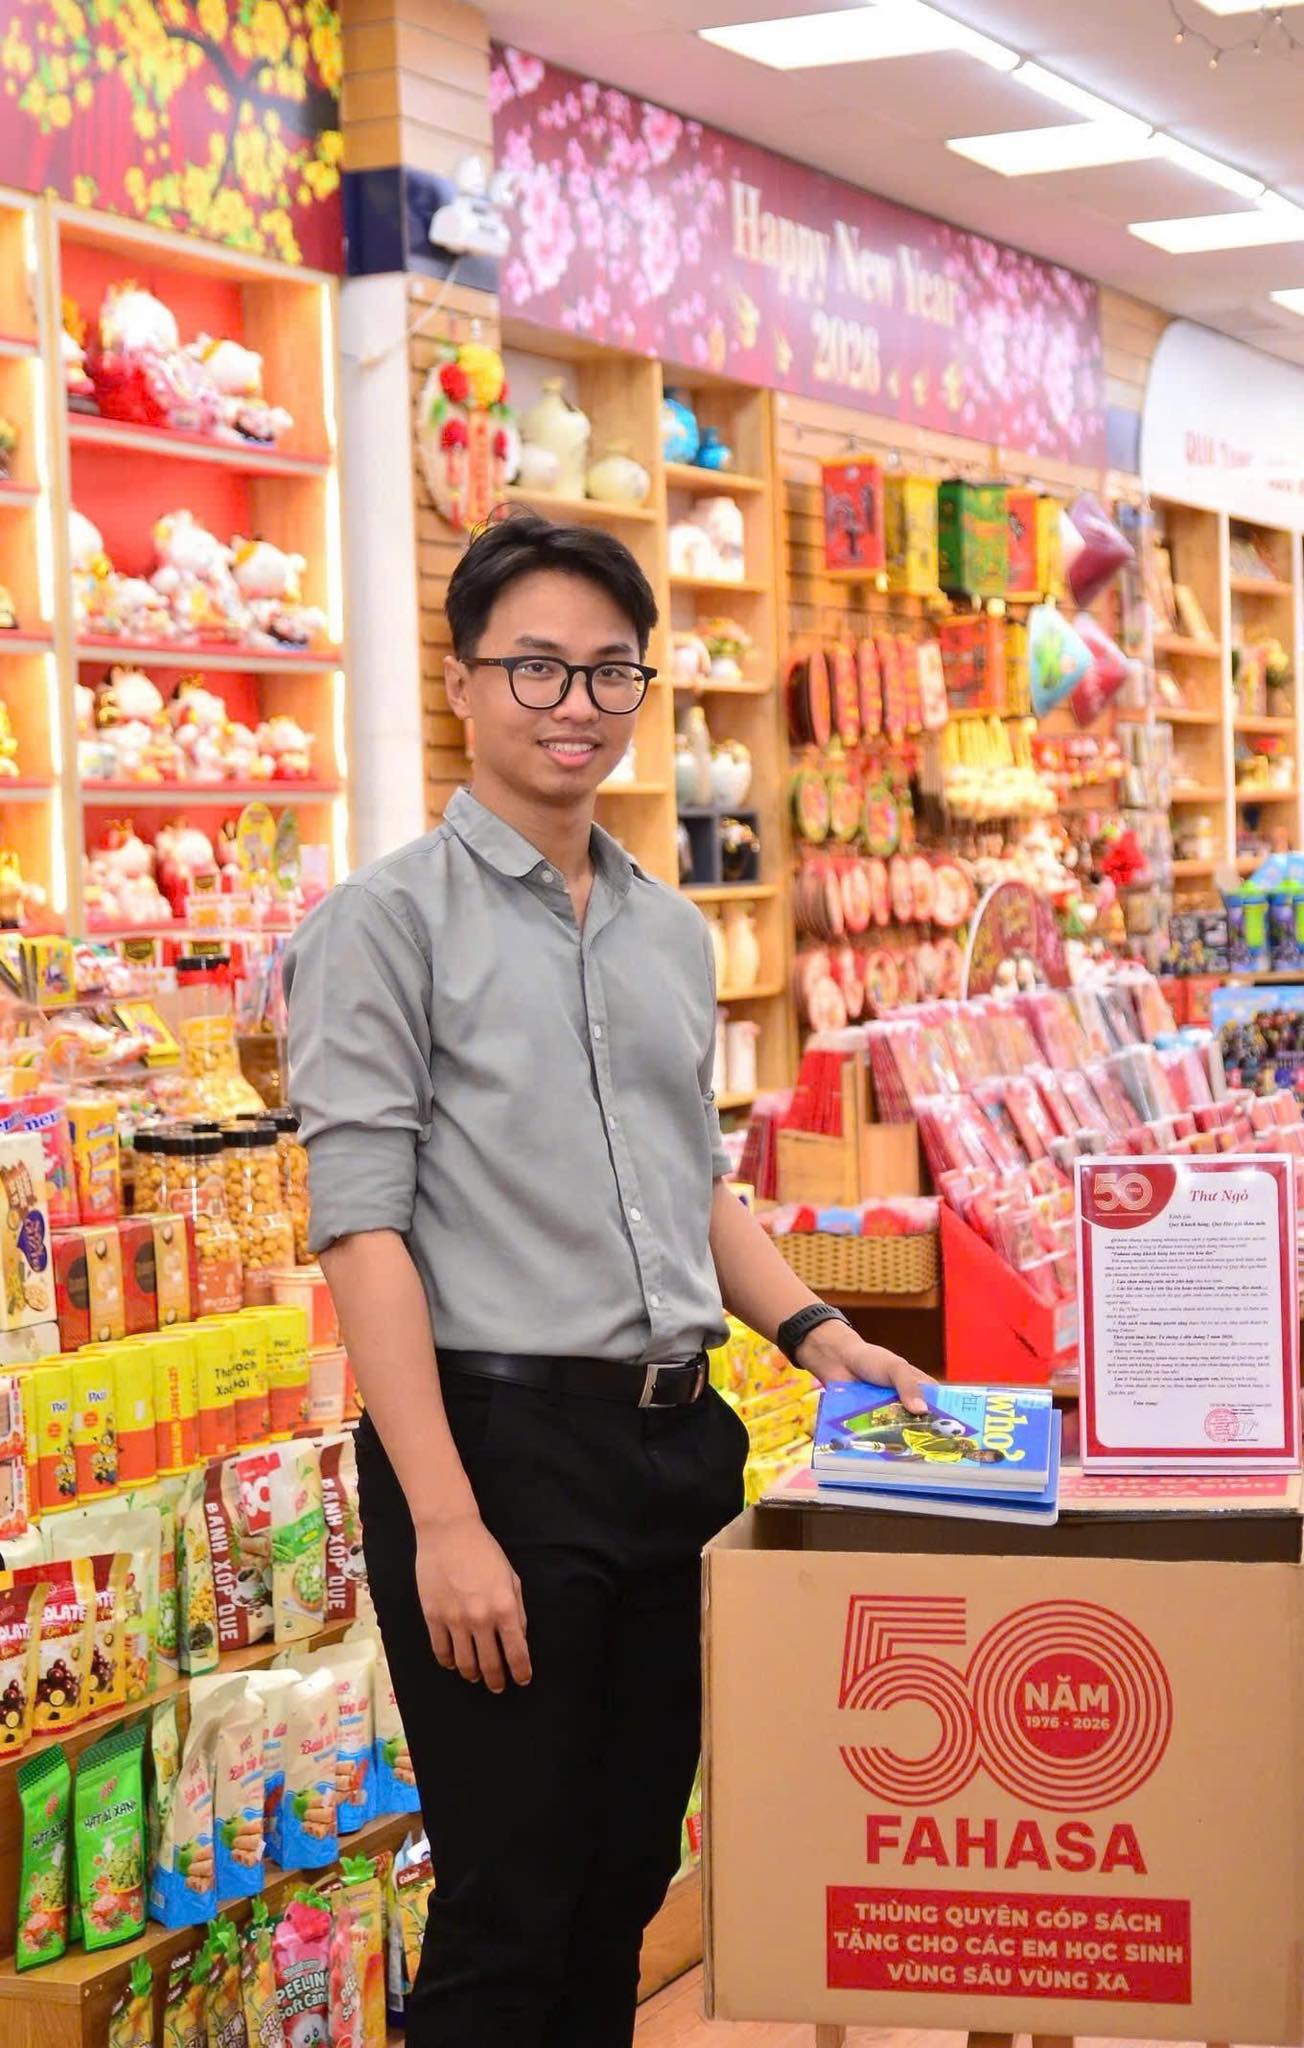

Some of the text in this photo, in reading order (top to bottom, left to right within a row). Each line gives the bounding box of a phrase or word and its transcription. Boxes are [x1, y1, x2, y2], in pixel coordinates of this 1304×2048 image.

[731, 179, 960, 328] Happy New Year
[811, 308, 880, 396] 2026
[1094, 1172, 1153, 1211] 50
[838, 1594, 1173, 1814] 50
[1024, 1673, 1110, 1714] NĂM
[1025, 1715, 1060, 1729] 1976
[1073, 1717, 1111, 1731] 2026
[866, 1814, 1148, 1875] FAHASA
[855, 1899, 1162, 1933] THÙNG QUYÊN GÓP SÁCH
[834, 1927, 1184, 1964] TẶNG CHO CÁC EM HỌC SINH
[887, 1959, 1130, 1992] VÙNG SÂU VÙNG XA
